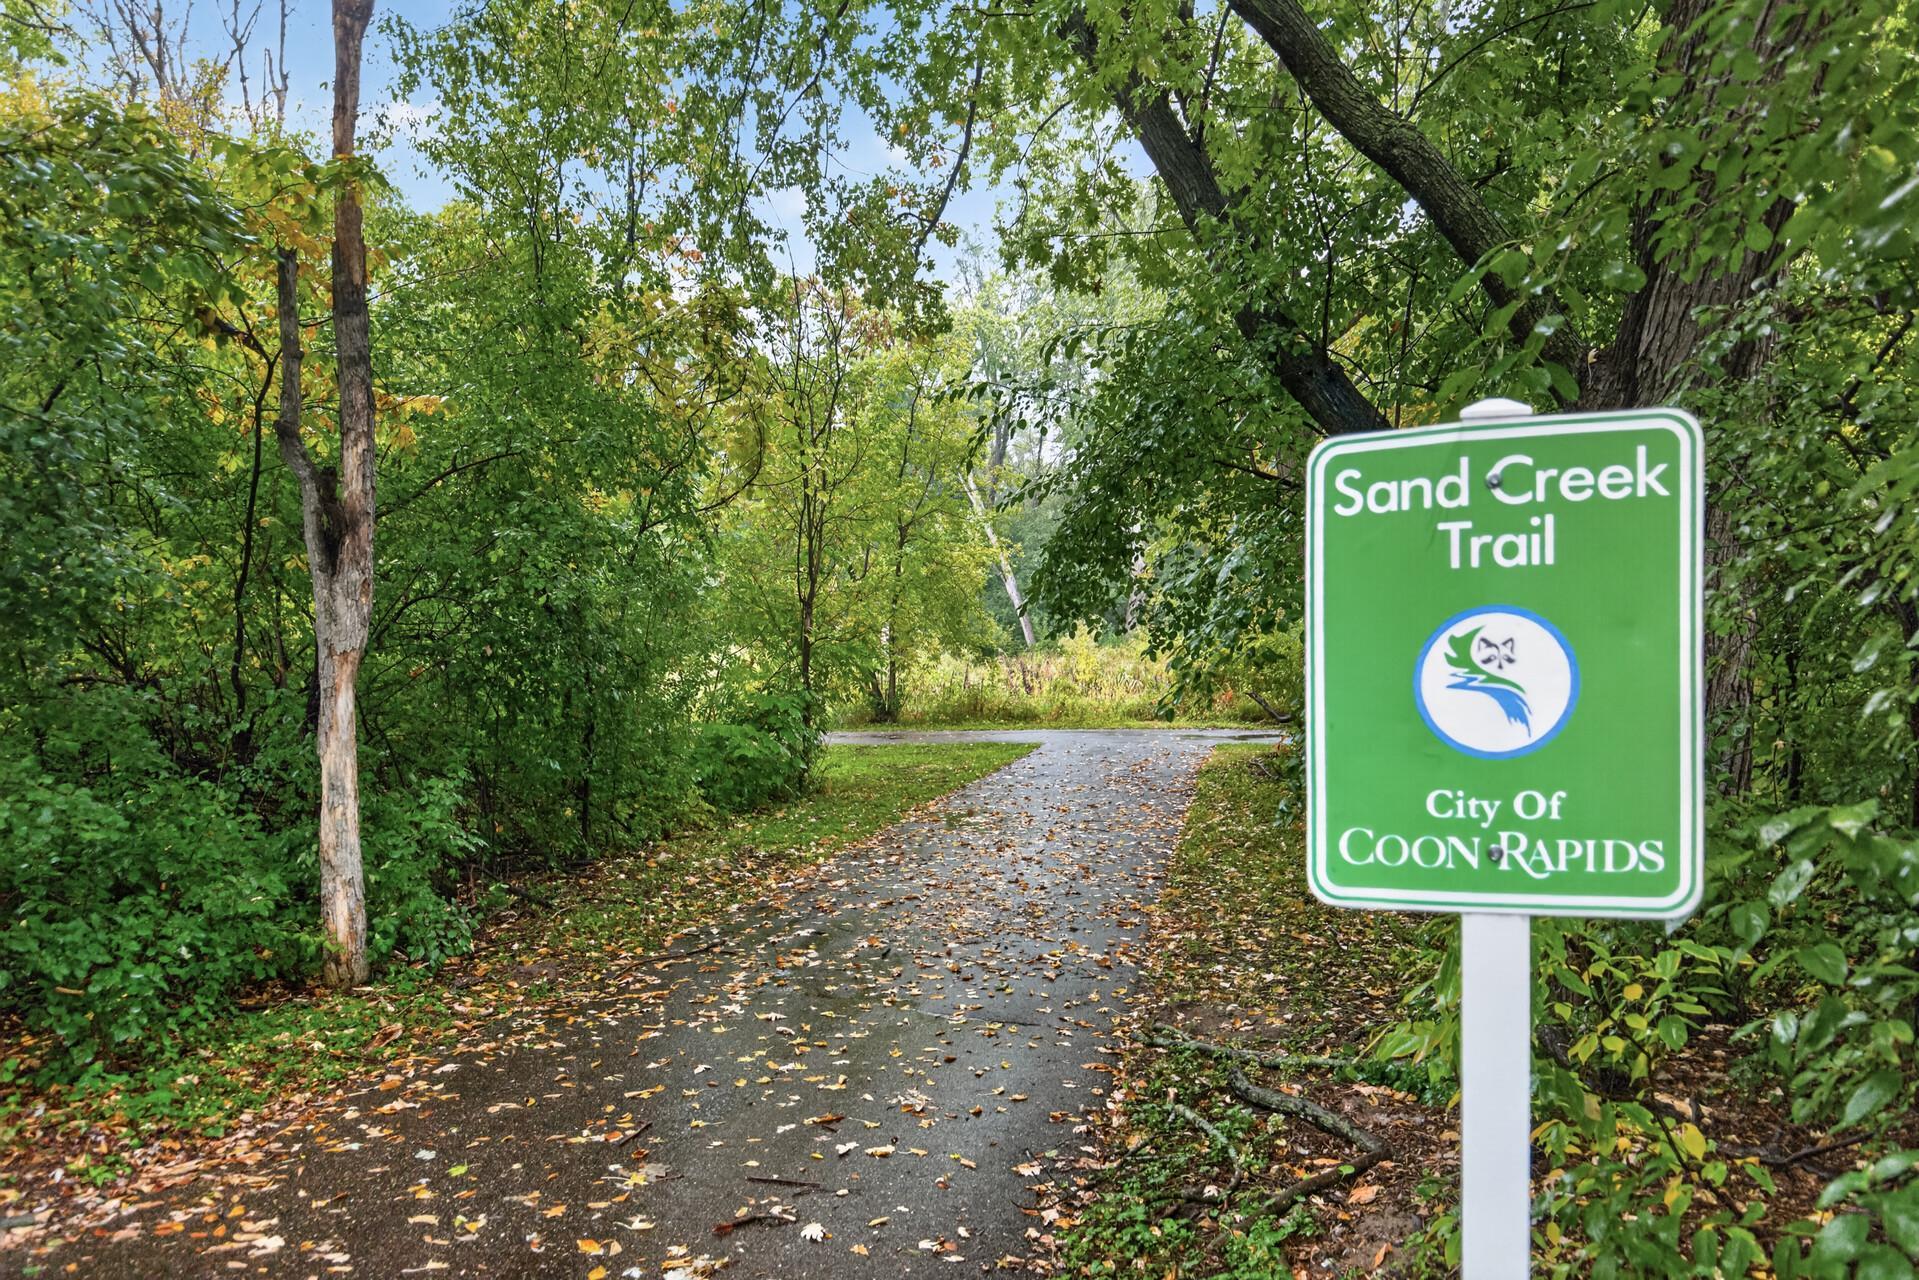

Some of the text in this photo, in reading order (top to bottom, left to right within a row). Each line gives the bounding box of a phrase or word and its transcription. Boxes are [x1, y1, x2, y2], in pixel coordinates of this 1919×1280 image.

[1333, 445, 1670, 517] Sand Creek
[1437, 514, 1555, 569] Trail
[1426, 789, 1567, 828] City Of
[1338, 827, 1665, 879] COON RAPIDS
